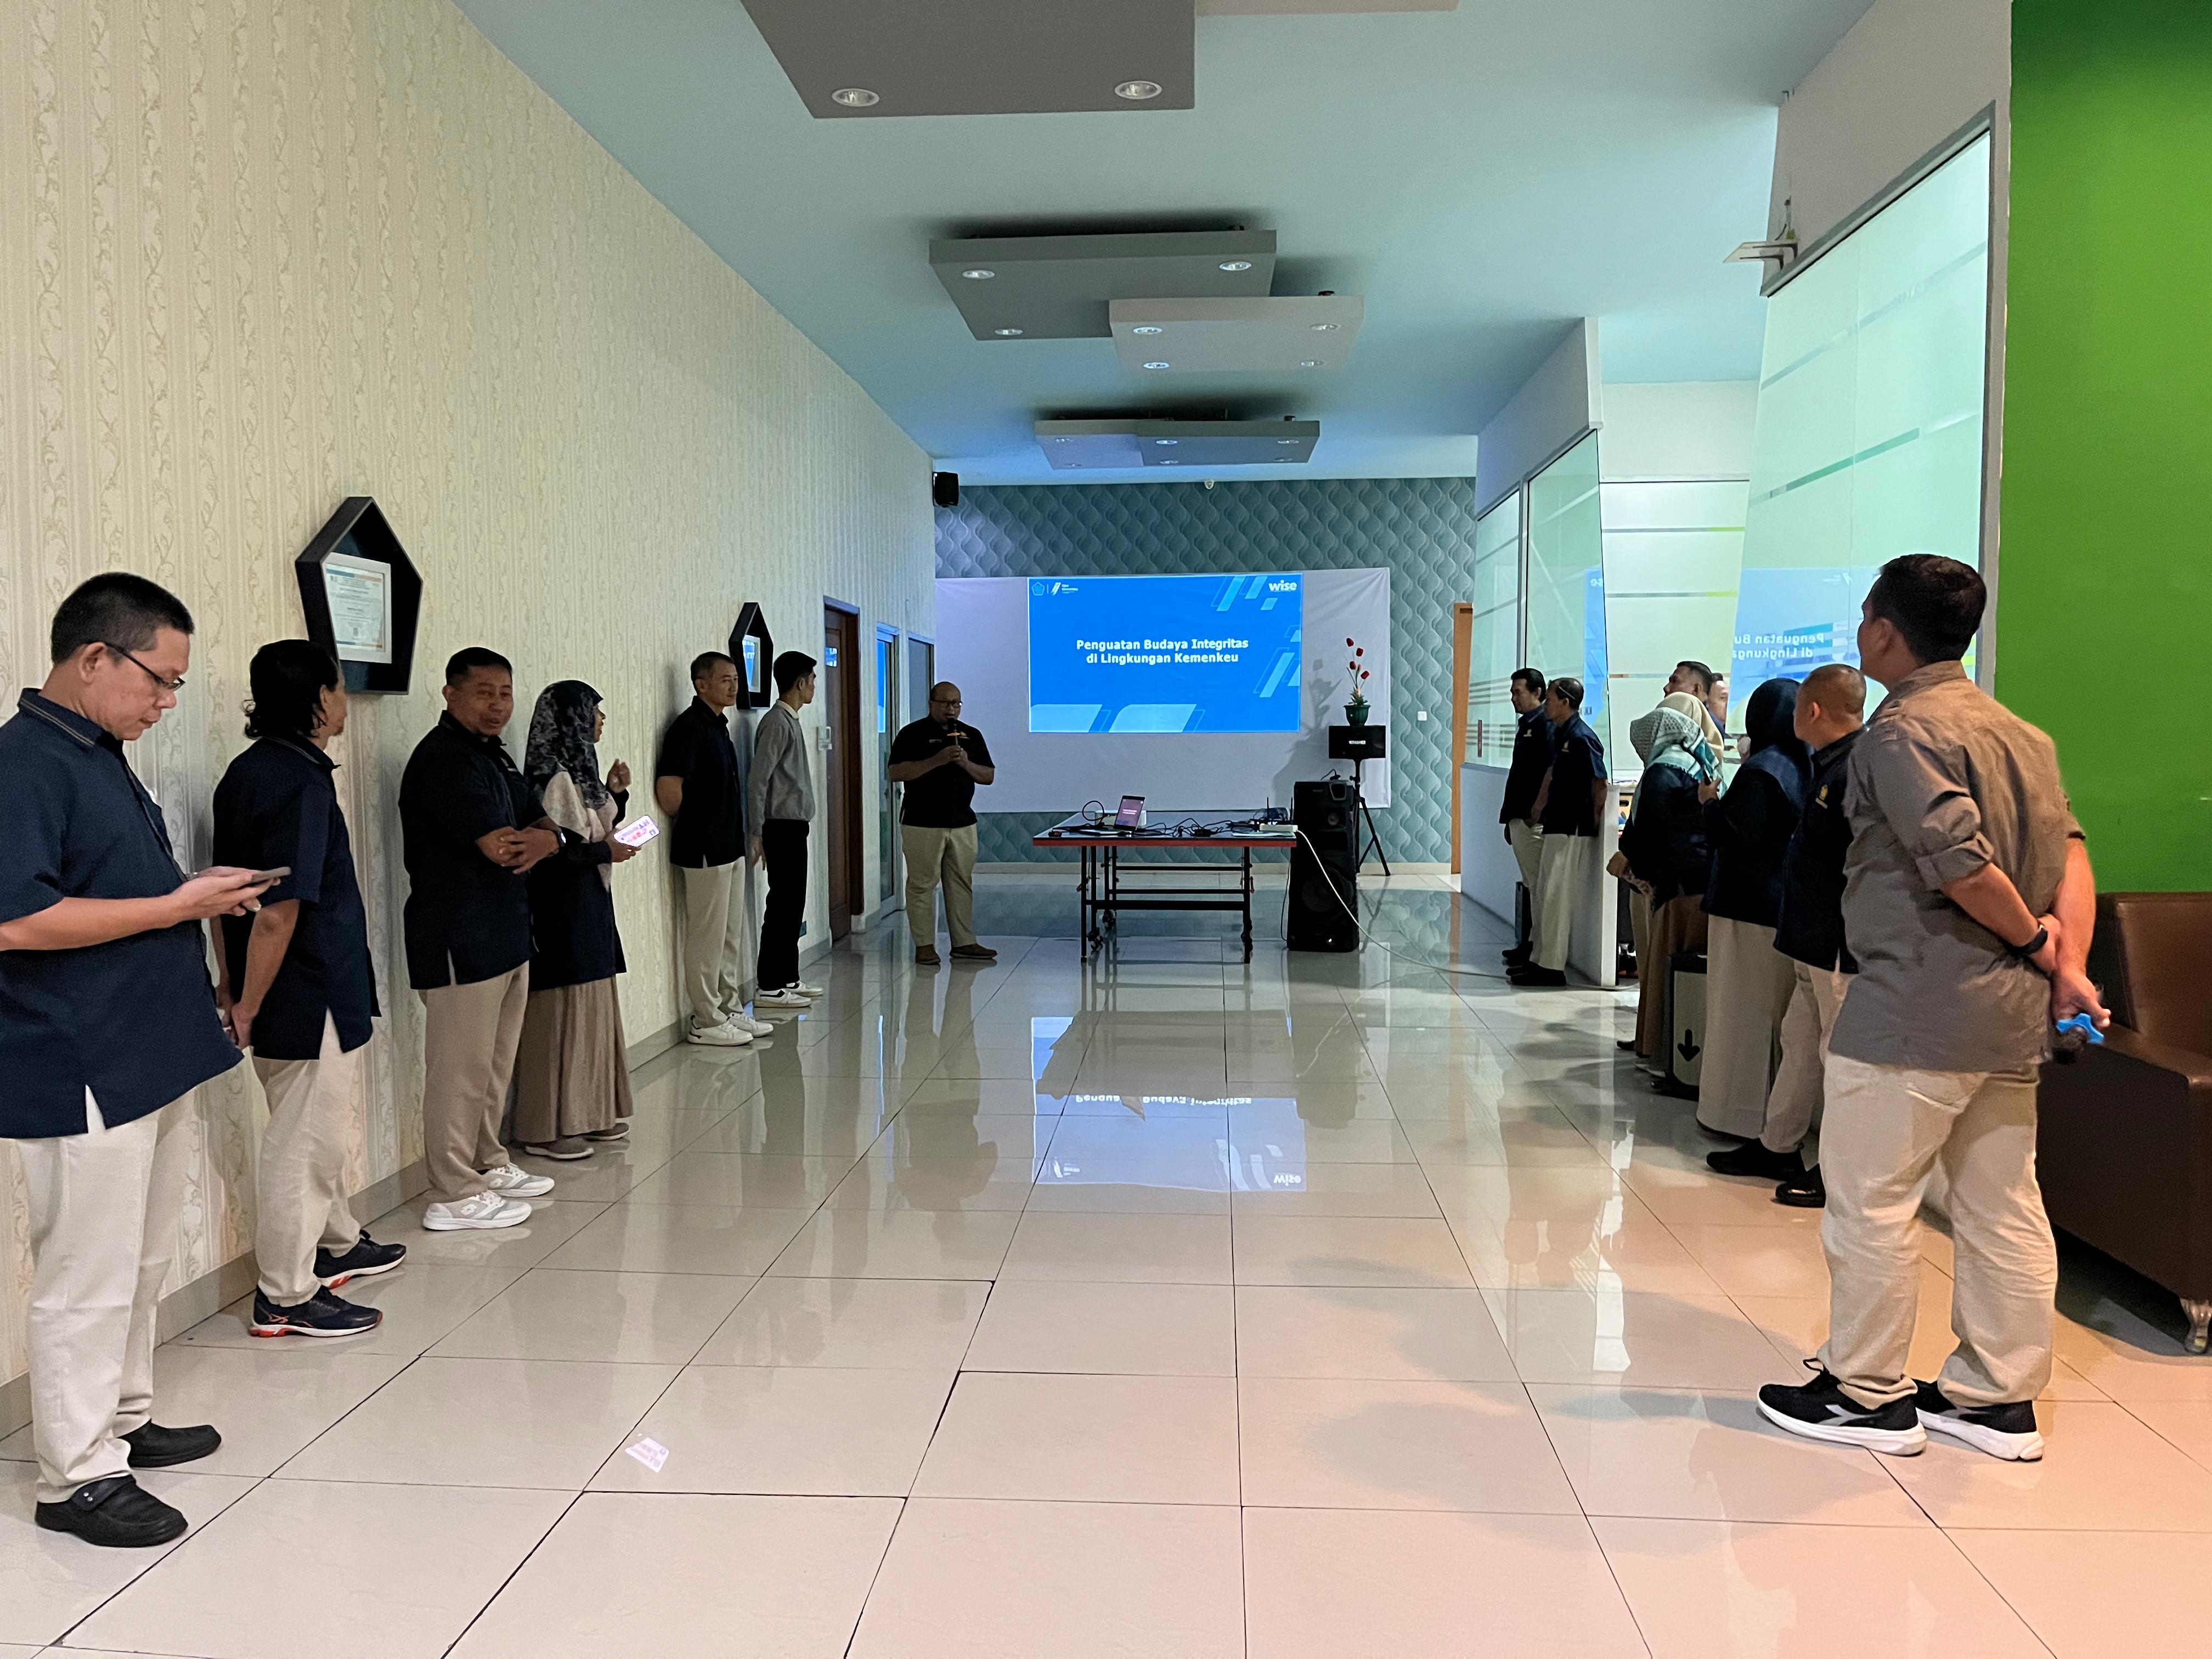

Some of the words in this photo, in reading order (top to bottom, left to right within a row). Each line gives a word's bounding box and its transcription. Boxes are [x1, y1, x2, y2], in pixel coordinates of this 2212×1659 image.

[1268, 580, 1297, 591] wise
[1076, 639, 1141, 652] Penguatan
[1144, 639, 1188, 651] Budaya
[1191, 638, 1249, 651] Integritas
[1086, 653, 1097, 663] di
[1101, 653, 1171, 665] Lingkungan
[1175, 652, 1239, 663] Kemenkeu
